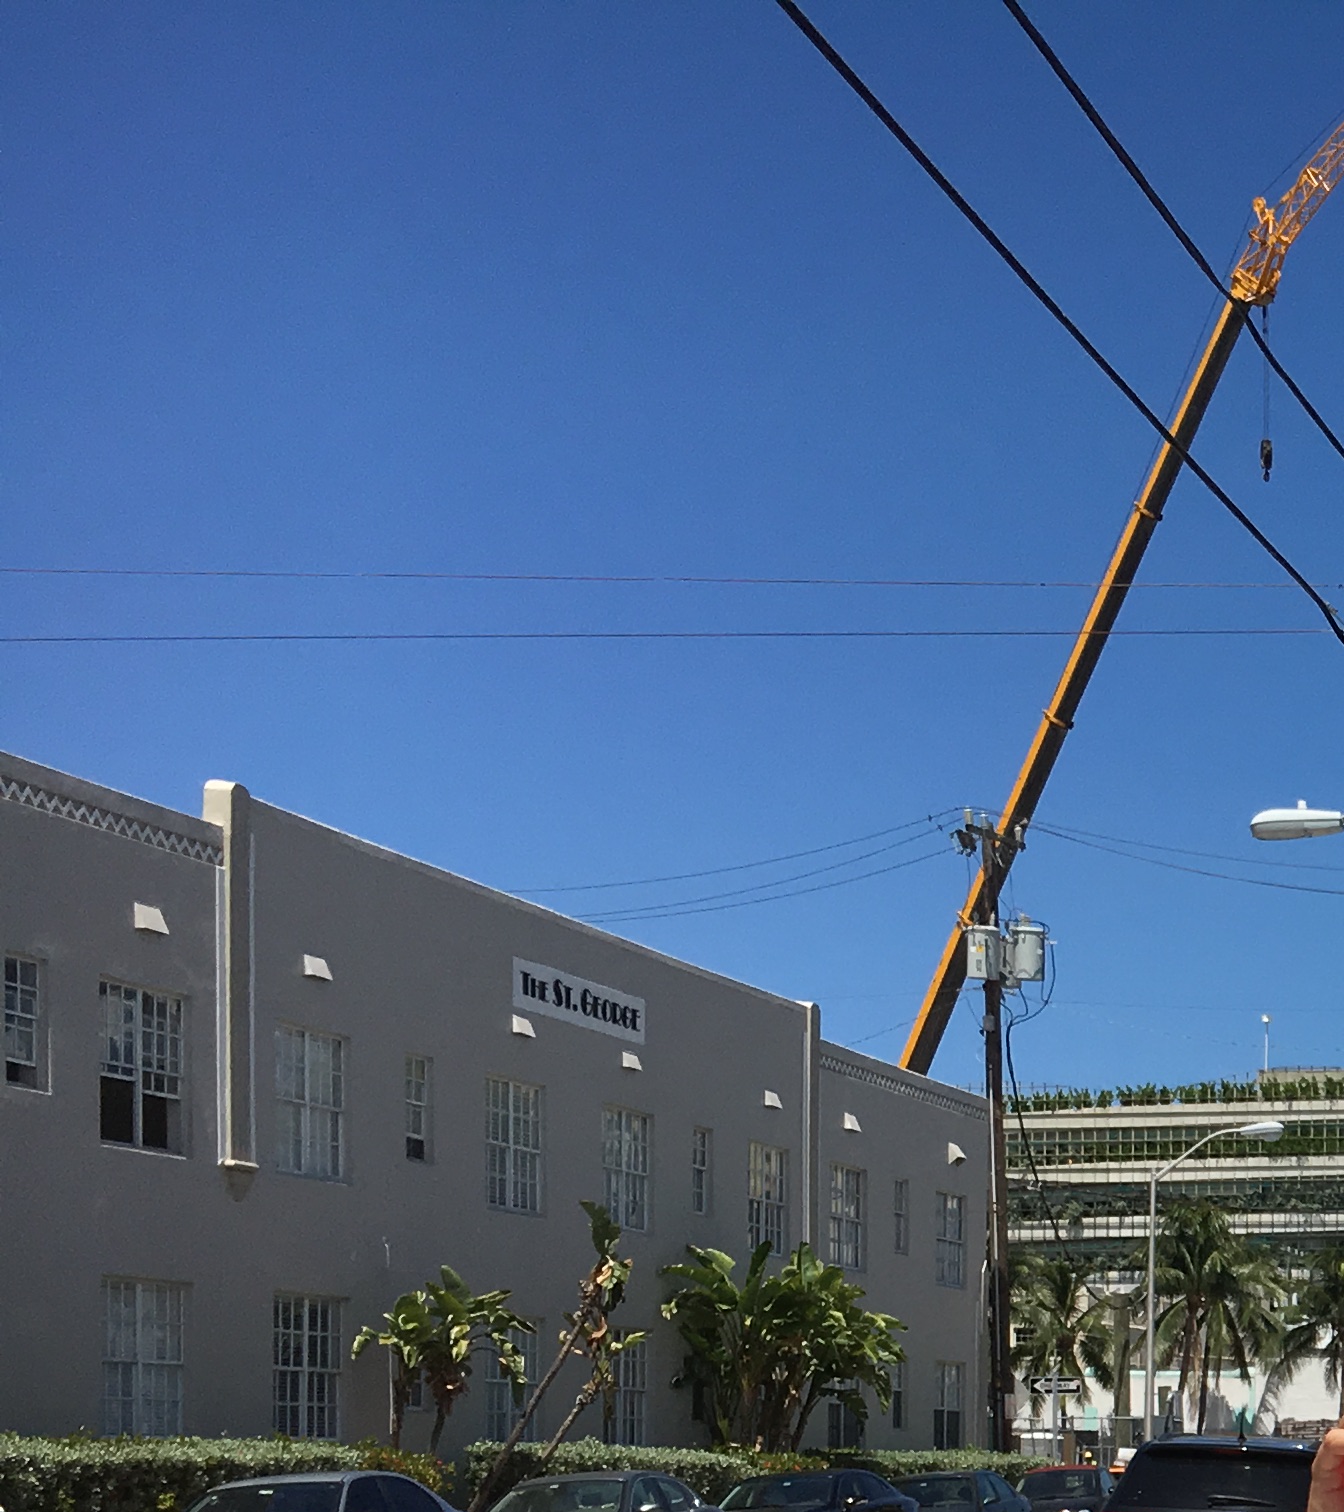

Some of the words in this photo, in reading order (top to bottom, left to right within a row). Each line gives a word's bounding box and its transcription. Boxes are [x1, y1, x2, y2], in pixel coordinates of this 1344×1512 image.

[520, 970, 549, 1003] THE
[552, 978, 578, 1012] ST.
[580, 988, 641, 1032] GEORGE
